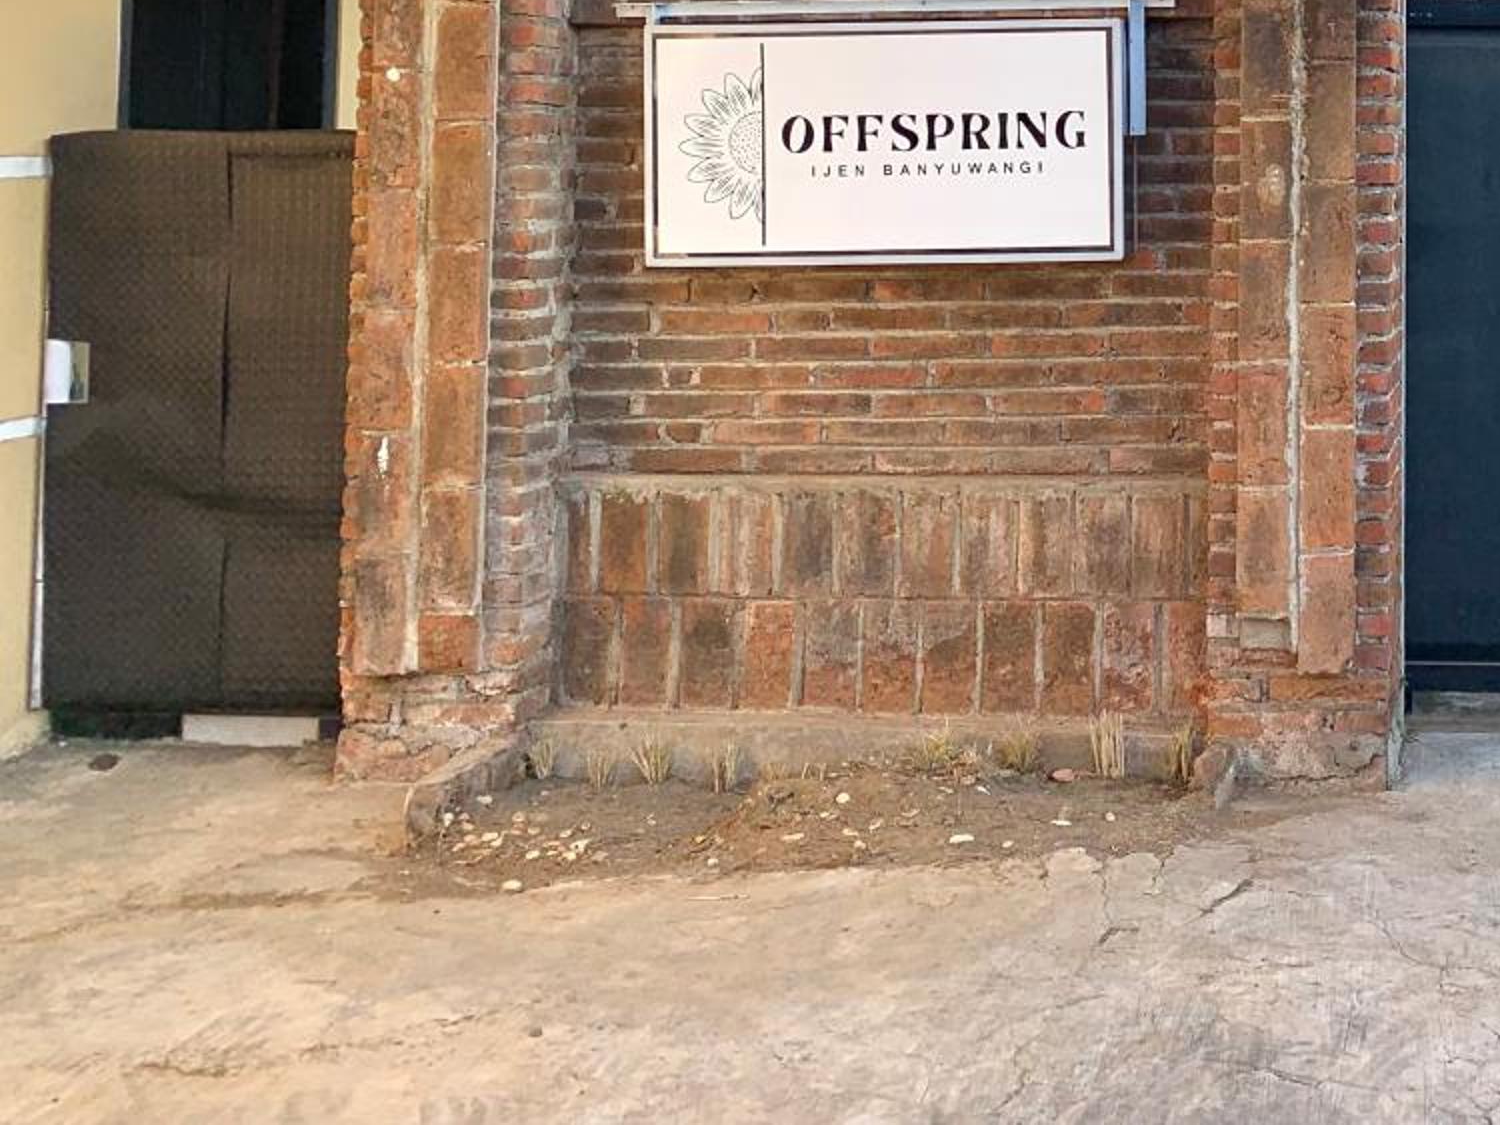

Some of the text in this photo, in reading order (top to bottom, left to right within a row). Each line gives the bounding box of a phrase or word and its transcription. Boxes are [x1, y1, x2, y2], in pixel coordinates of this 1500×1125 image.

[781, 110, 1086, 153] OFFSPRING
[811, 161, 1044, 178] IJEN BANYUWANGI
